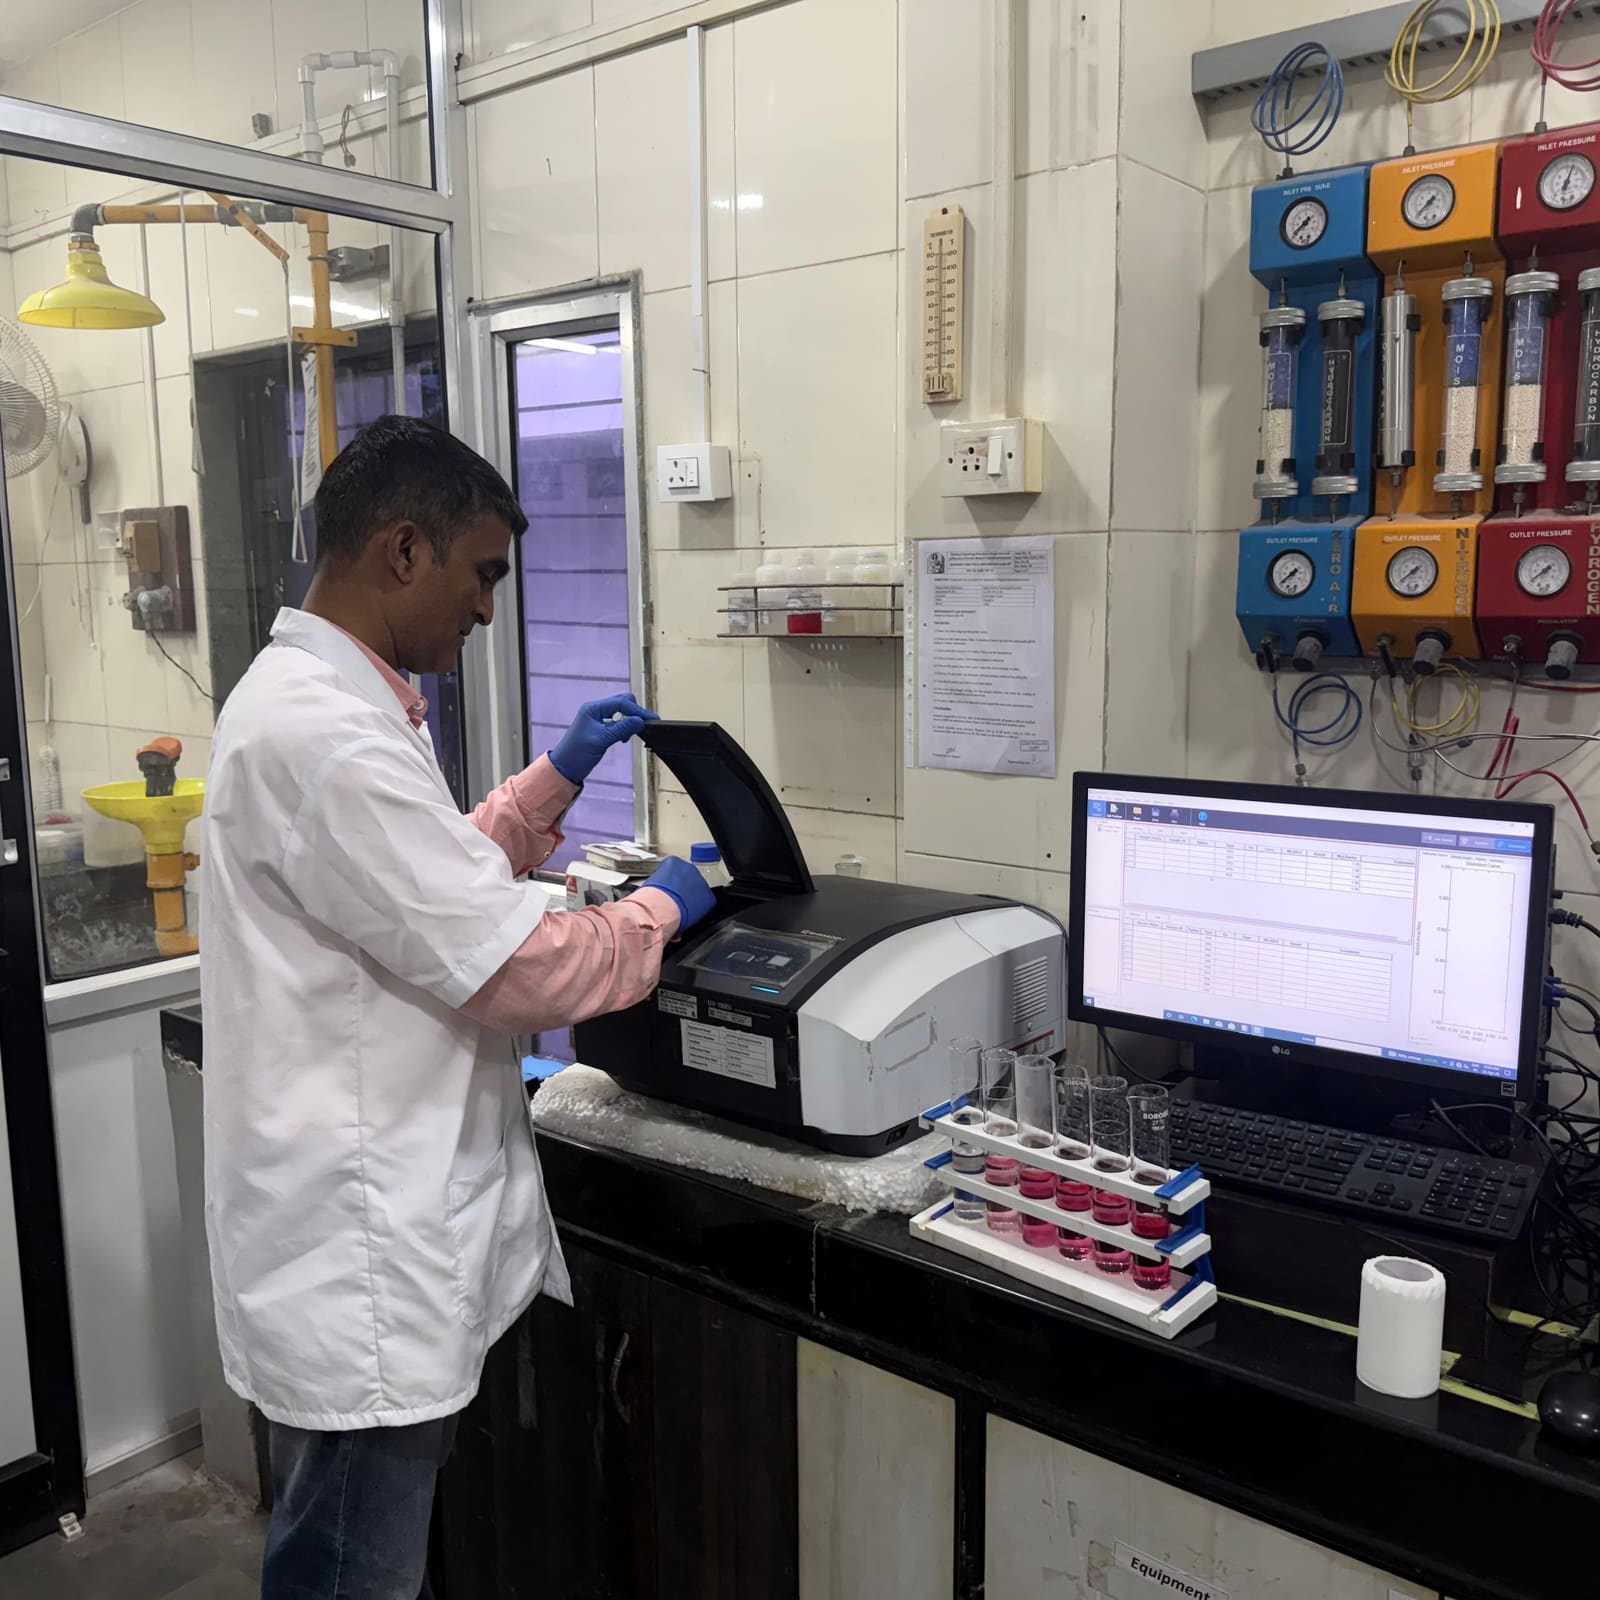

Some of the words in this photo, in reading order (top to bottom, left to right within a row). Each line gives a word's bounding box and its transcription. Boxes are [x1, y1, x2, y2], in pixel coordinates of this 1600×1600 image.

[1537, 141, 1557, 152] INLET
[1558, 134, 1597, 148] PRESSURE
[1283, 185, 1300, 196] INLET
[1587, 330, 1600, 420] HYDROCARBON
[1266, 537, 1288, 545] OUTLET
[1289, 536, 1320, 544] PRESSURE
[1383, 535, 1407, 543] OUTLET
[1509, 531, 1535, 539] OUTLET
[1536, 529, 1573, 538] PRESSURE
[1330, 530, 1343, 575] ZERO
[1586, 522, 1600, 615] HYDROGEN
[1328, 582, 1341, 613] AIR
[1280, 1047, 1290, 1056] LG
[1130, 1556, 1212, 1600] Equipment
